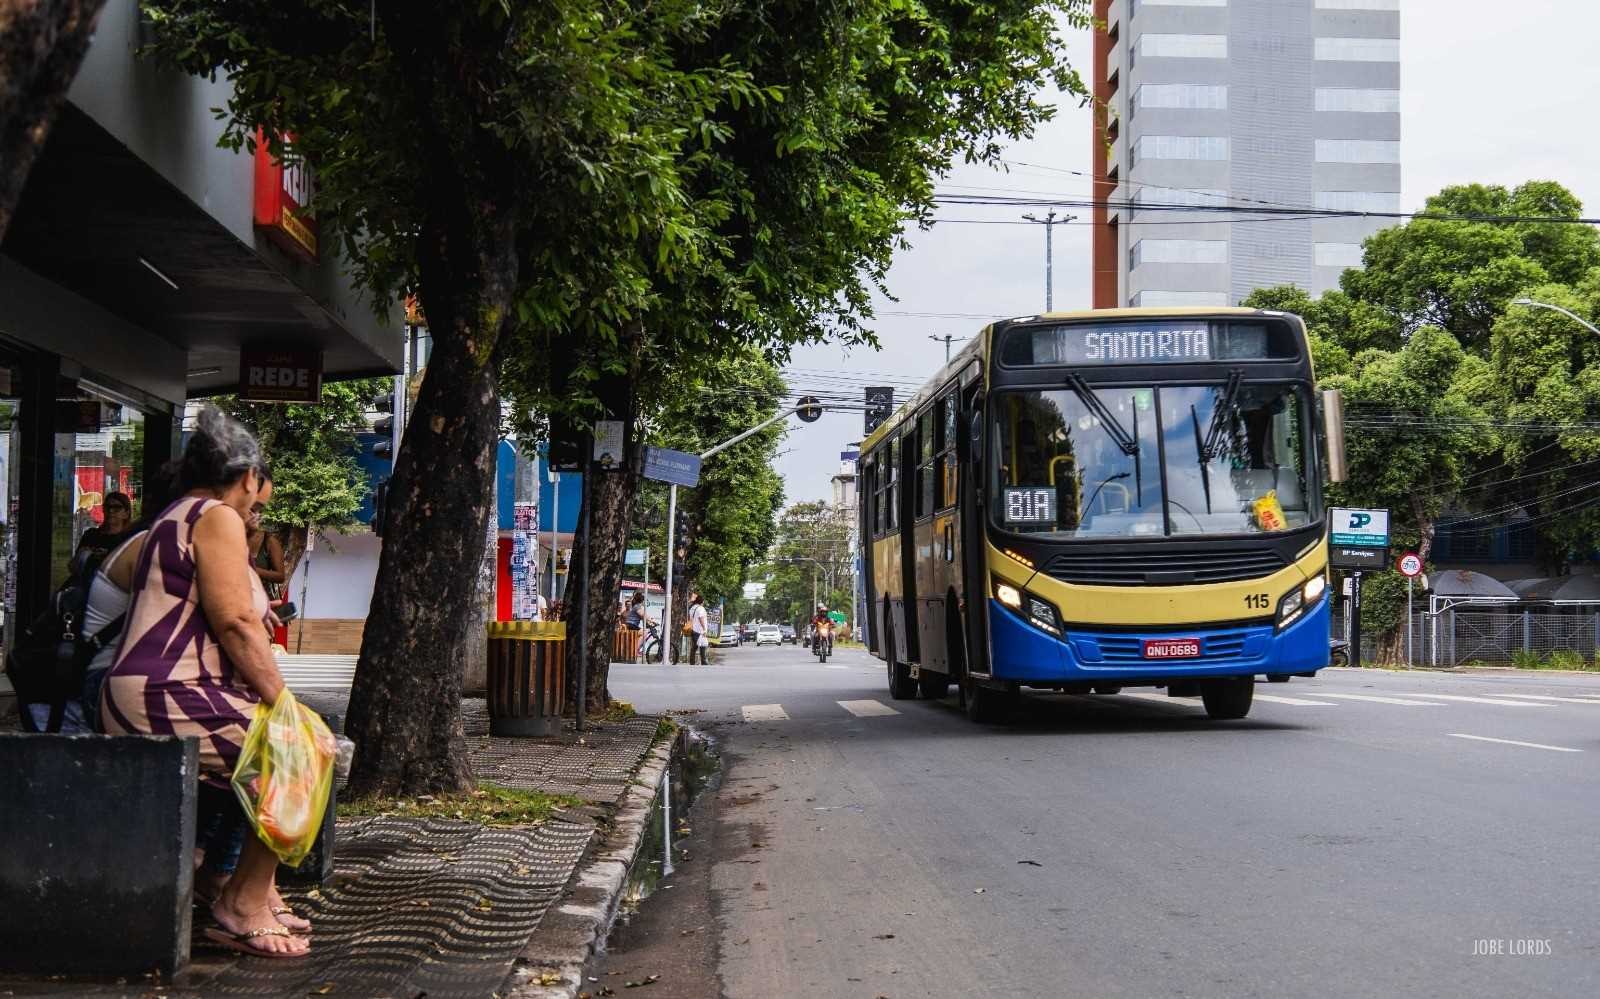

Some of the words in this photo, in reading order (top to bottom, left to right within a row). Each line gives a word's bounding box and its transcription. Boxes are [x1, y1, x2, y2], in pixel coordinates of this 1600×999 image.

[1085, 331, 1155, 358] SANTA
[1158, 330, 1209, 356] RITA
[249, 366, 309, 388] REDE
[1008, 490, 1049, 520] 81A
[1244, 593, 1270, 609] 115
